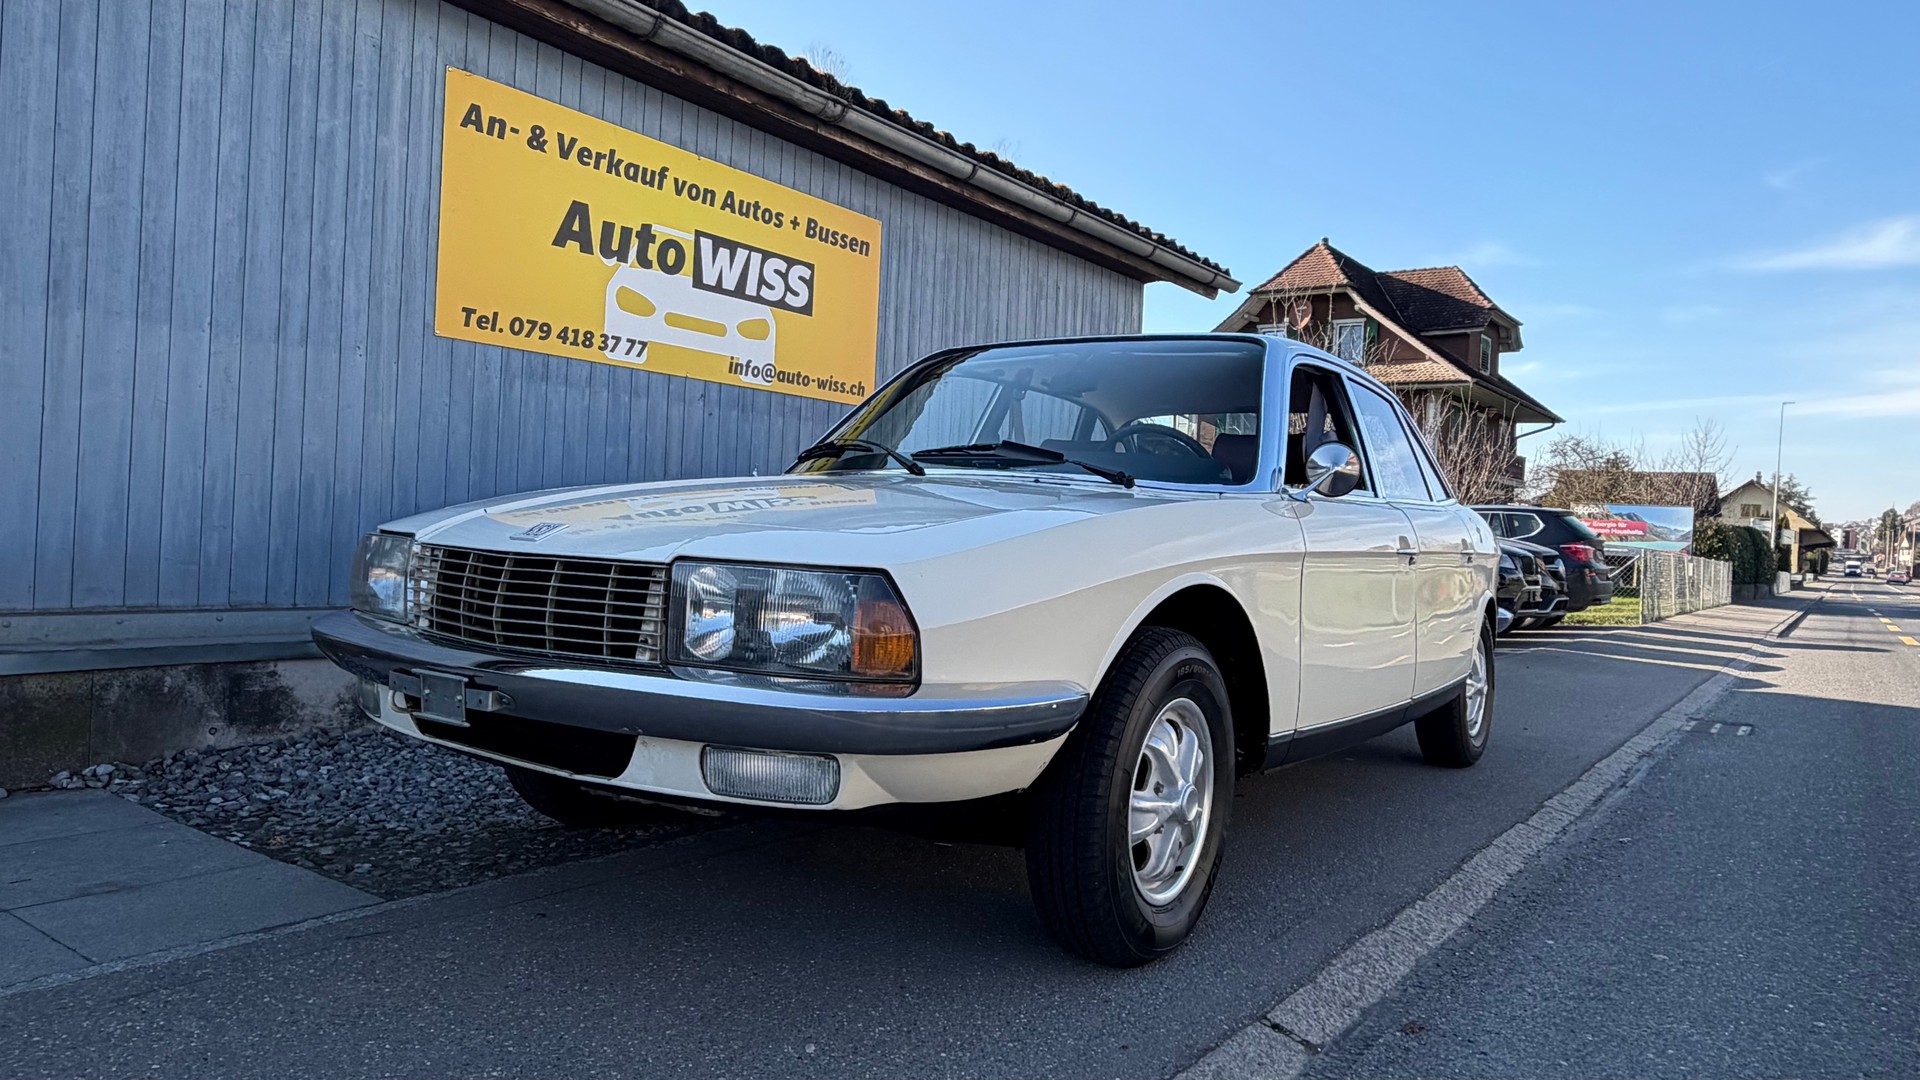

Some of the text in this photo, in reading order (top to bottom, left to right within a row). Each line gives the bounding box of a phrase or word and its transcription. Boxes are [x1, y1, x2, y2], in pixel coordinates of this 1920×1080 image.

[460, 103, 870, 256] An- & Verkauf von Autos + Bussen
[551, 200, 812, 308] Auto WISS
[462, 307, 648, 358] Tel. 079 418 37 77
[728, 356, 865, 397] info@auto-wiss.ch
